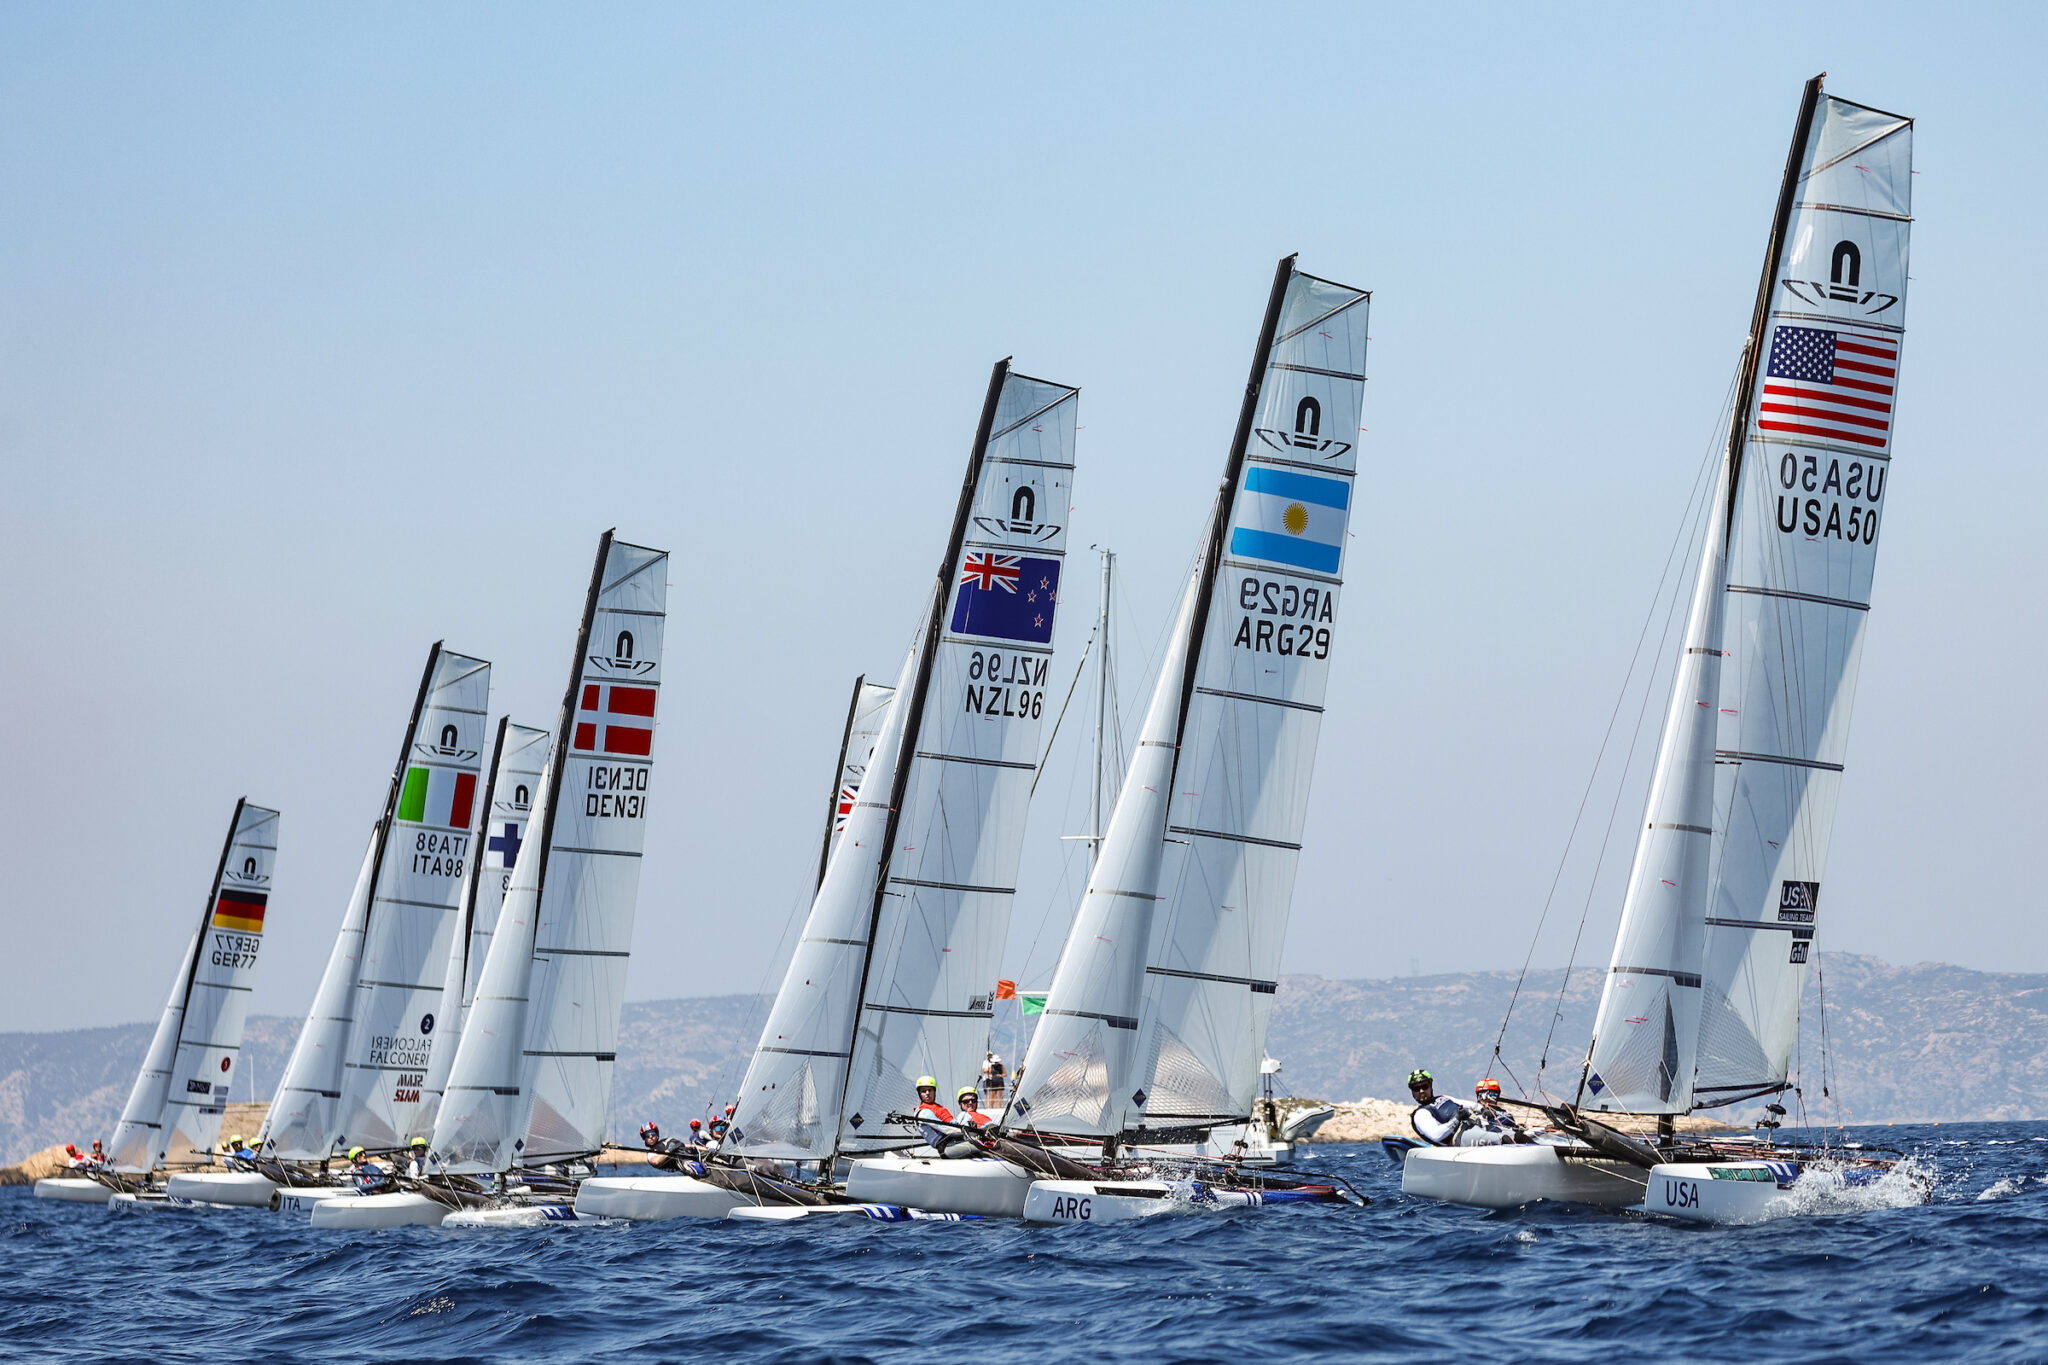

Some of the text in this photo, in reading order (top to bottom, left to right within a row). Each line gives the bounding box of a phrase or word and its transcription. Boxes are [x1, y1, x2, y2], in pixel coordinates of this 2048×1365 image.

[1778, 496, 1876, 545] USA50
[1233, 616, 1331, 660] ARG29
[965, 684, 1043, 720] NZL96
[413, 854, 463, 878] ITA98
[1779, 912, 1814, 922] SAILING TEAM
[212, 951, 257, 969] GER77
[1791, 943, 1808, 962] Gill
[423, 1018, 431, 1030] 2
[369, 1050, 430, 1066] FALCONERI
[393, 1089, 420, 1103] SLAM
[282, 1197, 300, 1211] ITA
[1666, 1181, 1699, 1208] USA
[1052, 1196, 1091, 1220] ARG
